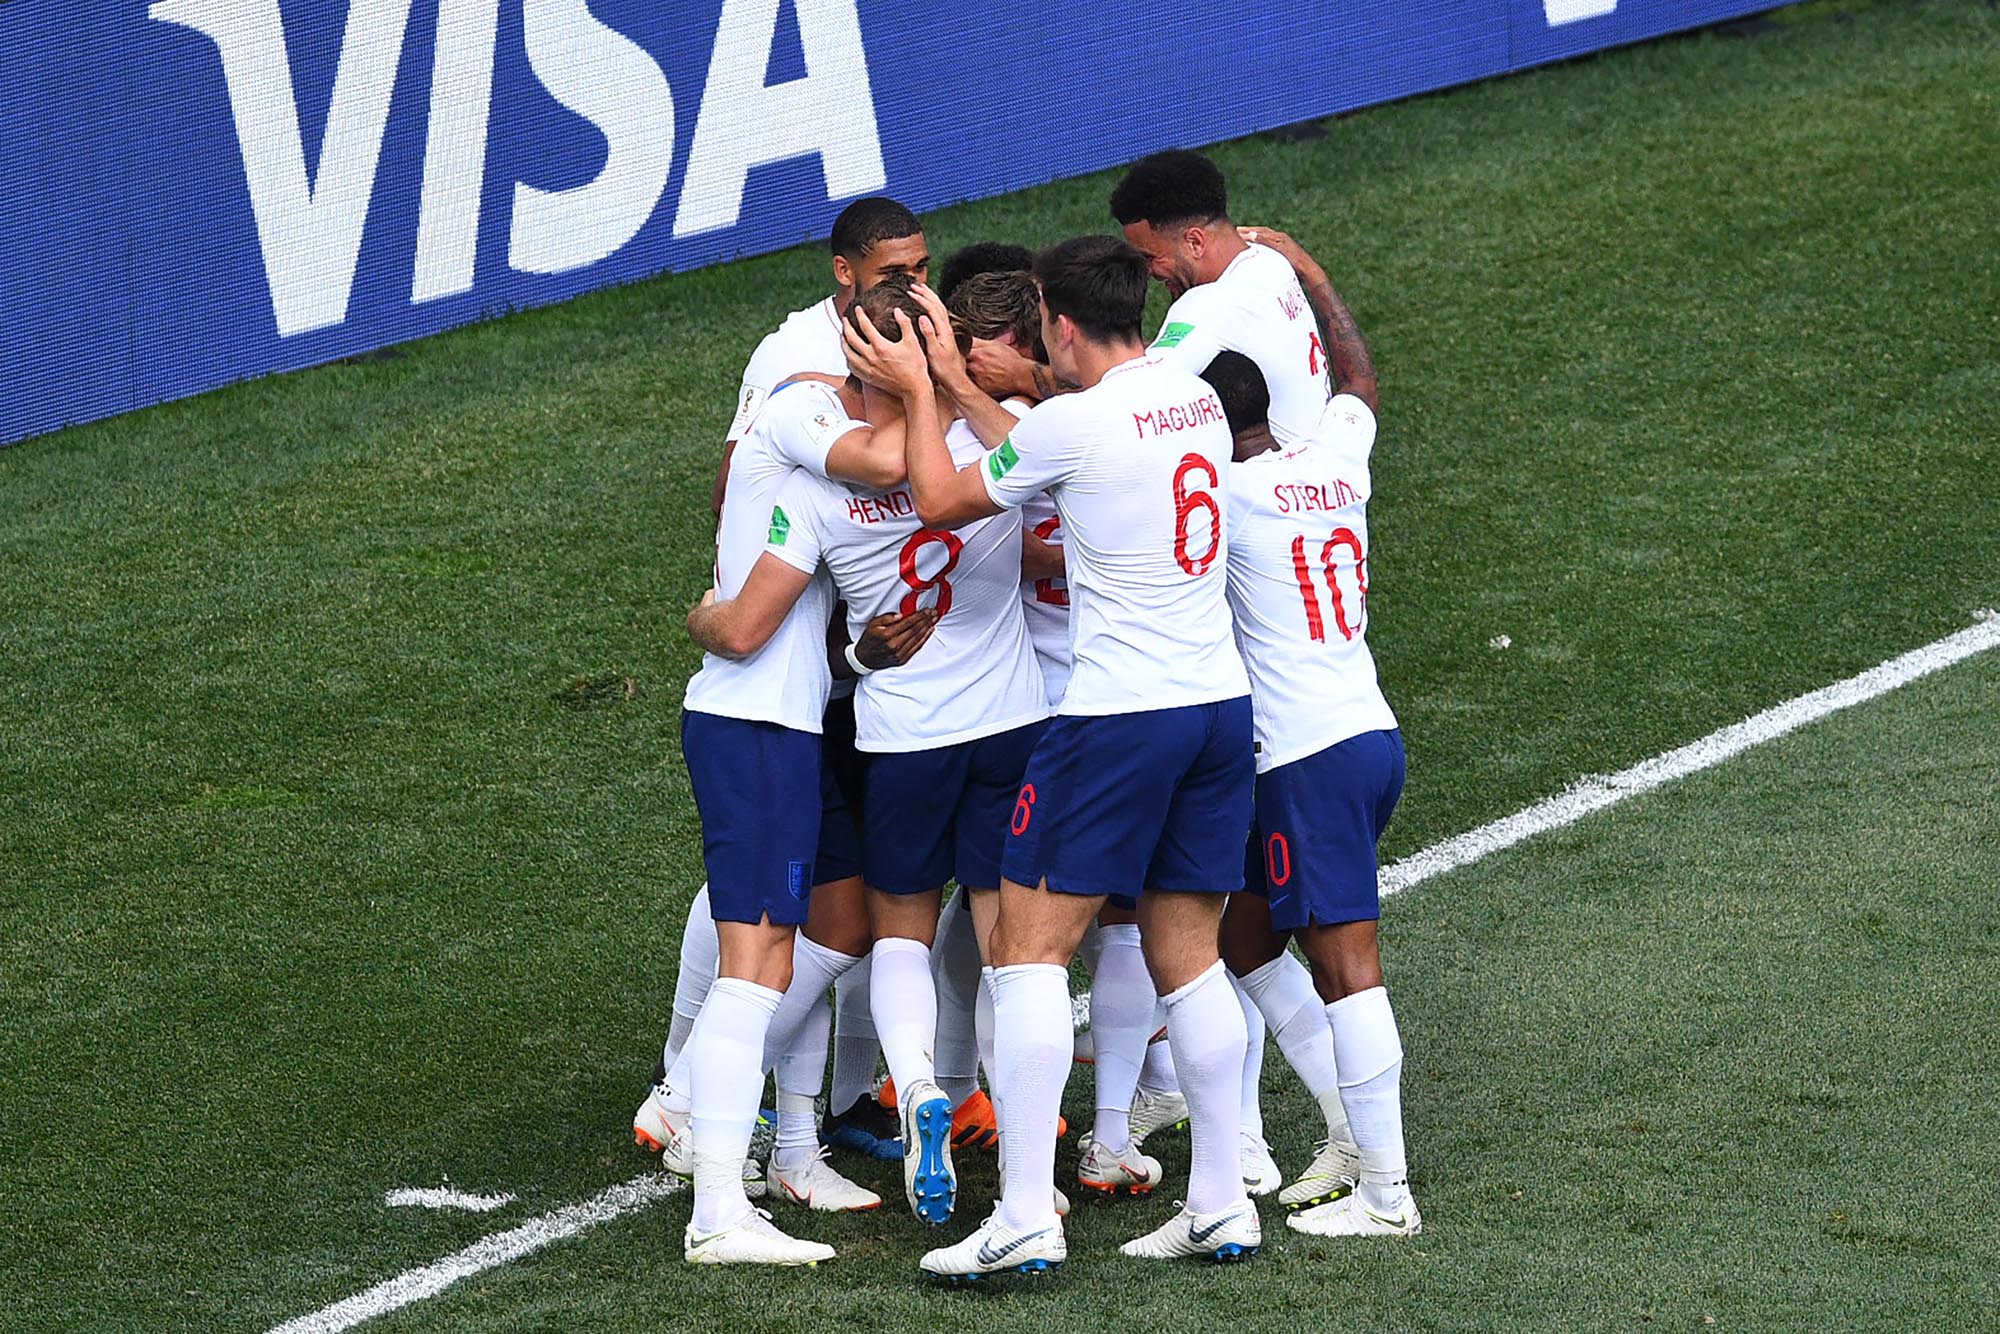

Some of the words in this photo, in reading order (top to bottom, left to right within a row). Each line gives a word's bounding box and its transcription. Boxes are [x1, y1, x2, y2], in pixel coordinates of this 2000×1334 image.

[148, 0, 886, 337] VISA
[1133, 394, 1224, 440] MAGUIRE
[845, 490, 914, 525] HEND
[1173, 452, 1221, 577] 6
[1274, 478, 1363, 513] STERLIN
[899, 526, 964, 624] 8
[1291, 526, 1369, 645] 10
[1011, 783, 1036, 837] 6
[1266, 831, 1291, 887] 0
